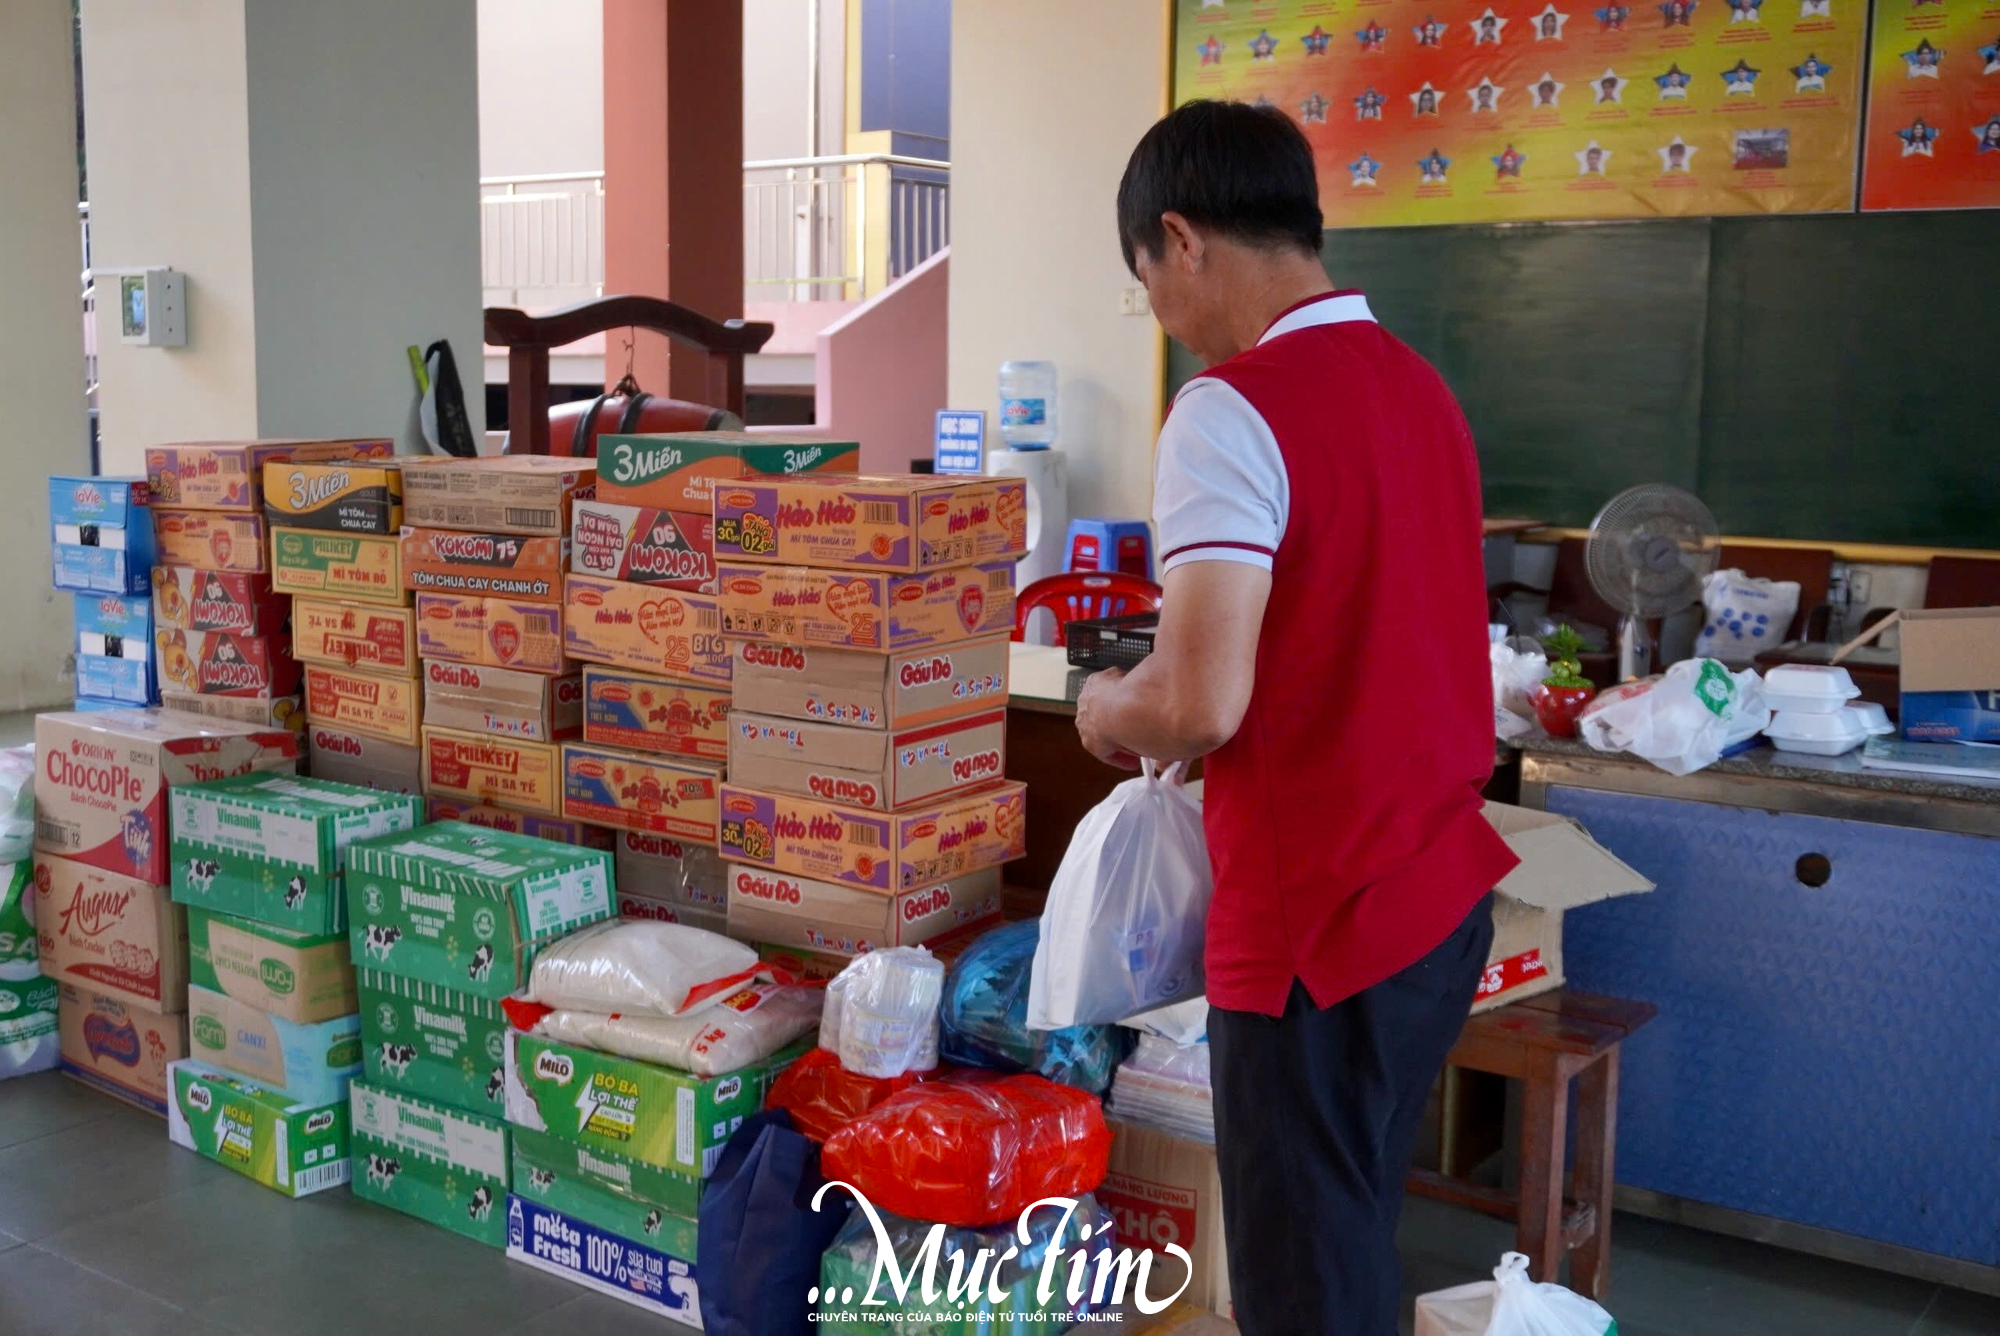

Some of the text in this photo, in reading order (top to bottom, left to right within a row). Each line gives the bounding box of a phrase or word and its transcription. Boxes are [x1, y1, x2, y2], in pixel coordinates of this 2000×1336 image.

[613, 444, 633, 481] 3
[341, 518, 376, 529] CHUA CAY
[776, 495, 856, 529] Hảo Hảo
[949, 501, 990, 534] Hảo Hảo
[434, 534, 517, 560] KOKOMI 75
[653, 524, 676, 544] 90
[741, 530, 763, 553] 02
[820, 536, 840, 545] CHUA
[630, 543, 708, 580] KOKOMI
[412, 571, 435, 585] TÔM
[436, 576, 465, 588] CHUA
[467, 577, 488, 589] CAY
[491, 580, 531, 592] CHANH
[926, 572, 956, 595] Hảo Hảo
[773, 586, 821, 606] Hảo Hảo
[194, 598, 249, 626] KOKOMI
[455, 605, 471, 619] Hảo
[595, 607, 633, 624] Hảo Hảo
[692, 634, 725, 656] BIG
[742, 643, 805, 670] Gấu Đỏ
[204, 660, 262, 687] KOKOMI
[430, 664, 481, 688] Gấu Đỏ
[900, 656, 952, 687] Gấu Đỏ
[82, 743, 117, 762] ORION
[47, 749, 143, 802] ChocoPie
[502, 779, 517, 790] SA
[217, 806, 262, 832] Vinamilk
[774, 812, 843, 841] Hảo Hảo
[70, 831, 80, 845] 12
[938, 814, 988, 853] Hảo Hảo
[401, 885, 455, 913] Vinamilk
[737, 872, 801, 905] Gấu Đỏ
[904, 886, 951, 921] Gấu Đỏ
[414, 1005, 467, 1034] Vinamilk
[237, 1029, 266, 1049] CANXI
[697, 1028, 727, 1055] 5 kg
[540, 1059, 569, 1076] MILO
[190, 1089, 209, 1106] MILO
[619, 1079, 639, 1096] BA
[718, 1083, 739, 1097] MILO
[308, 1116, 331, 1129] MILO
[398, 1105, 445, 1134] Vinamilk
[578, 1149, 631, 1183] Vinamilk
[534, 1234, 581, 1270] Fresh
[586, 1233, 627, 1282] 100%
